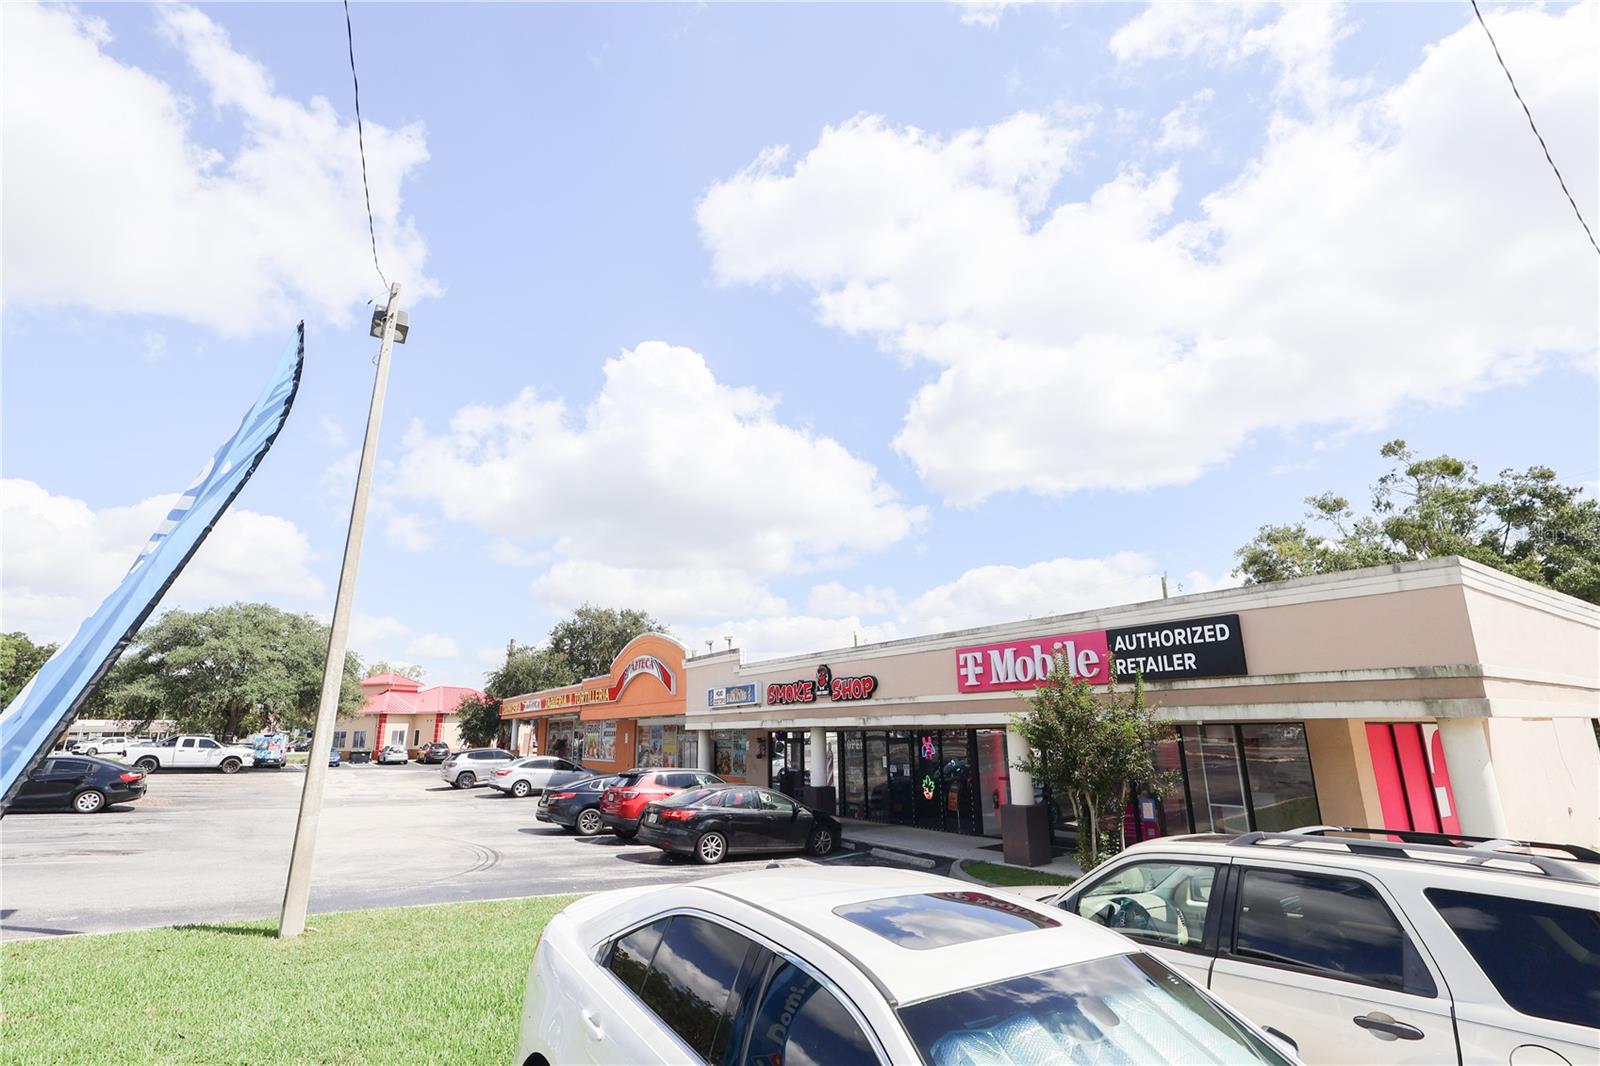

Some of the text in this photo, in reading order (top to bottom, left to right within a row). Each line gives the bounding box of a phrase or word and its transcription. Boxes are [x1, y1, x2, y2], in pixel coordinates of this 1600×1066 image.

[1114, 623, 1230, 652] AUTHORIZED
[1116, 652, 1197, 675] RETAILER
[767, 681, 814, 705] SMOKE
[831, 676, 874, 701] SHOP
